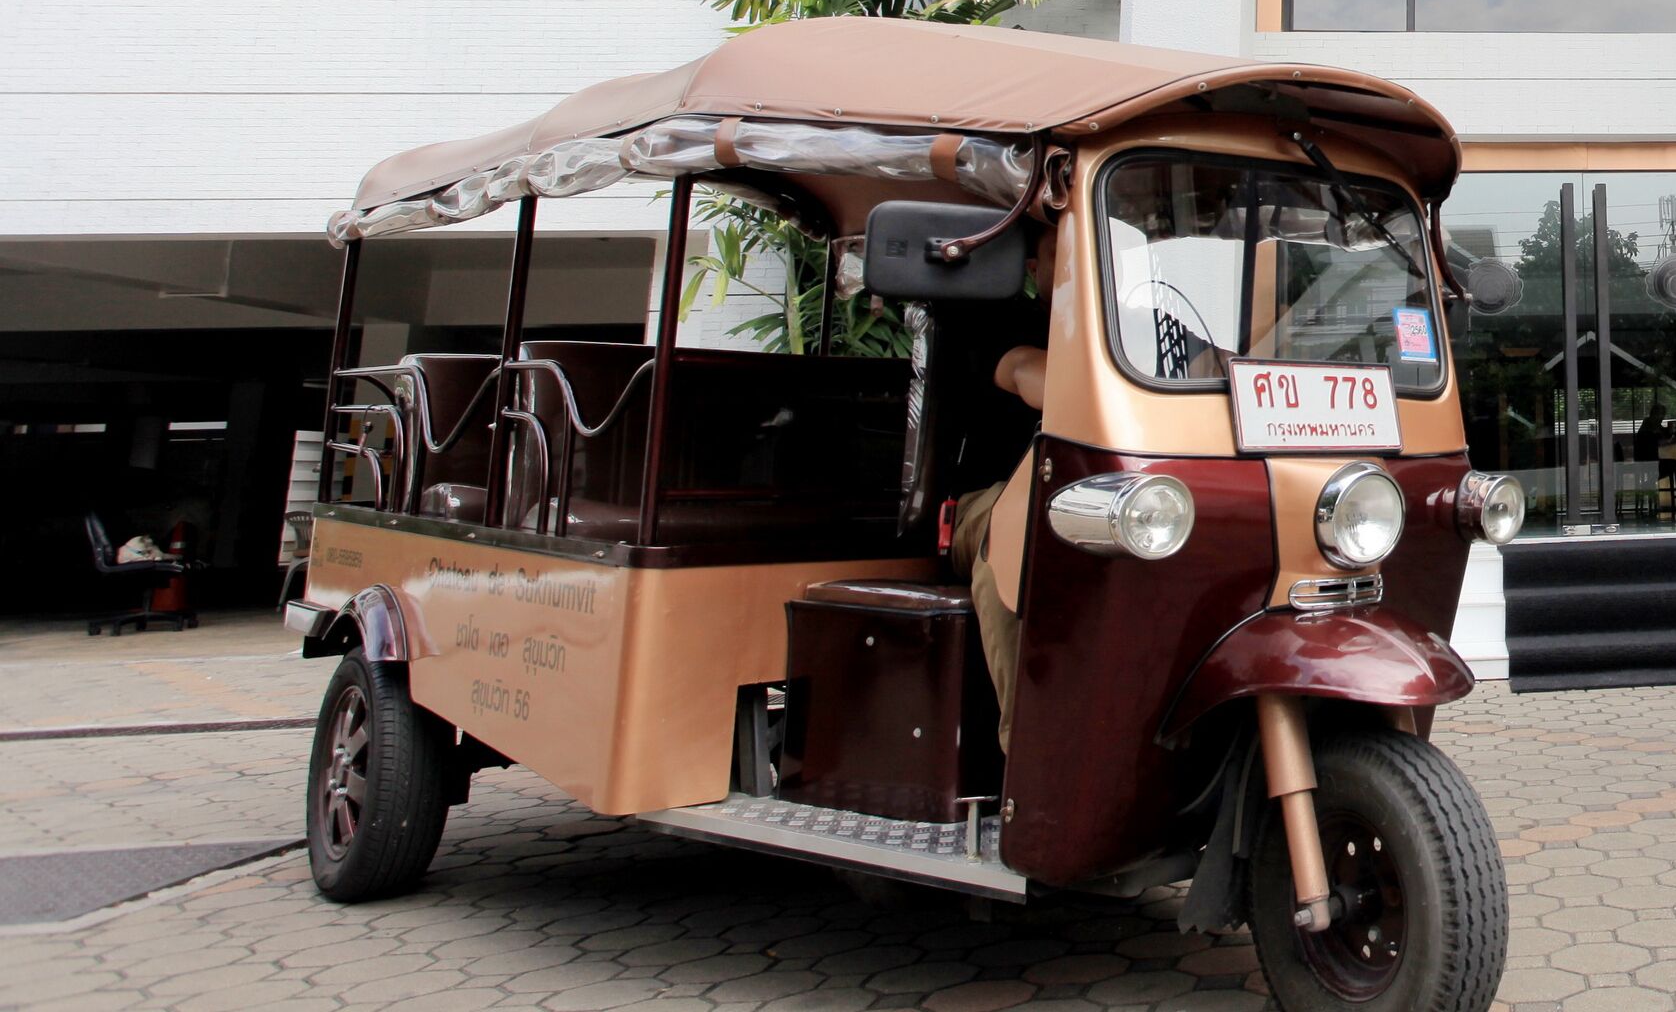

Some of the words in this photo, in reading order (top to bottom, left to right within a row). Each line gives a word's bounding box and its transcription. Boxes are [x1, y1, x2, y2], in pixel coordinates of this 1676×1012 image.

[1323, 375, 1378, 410] 778
[1266, 421, 1376, 443] กรุงเทพมหานคร
[488, 562, 506, 597] de
[515, 567, 597, 615] Sukhumvit
[522, 634, 566, 677] สุขุมวิท
[471, 678, 510, 717] สุขุมวิท
[513, 688, 531, 721] 56
